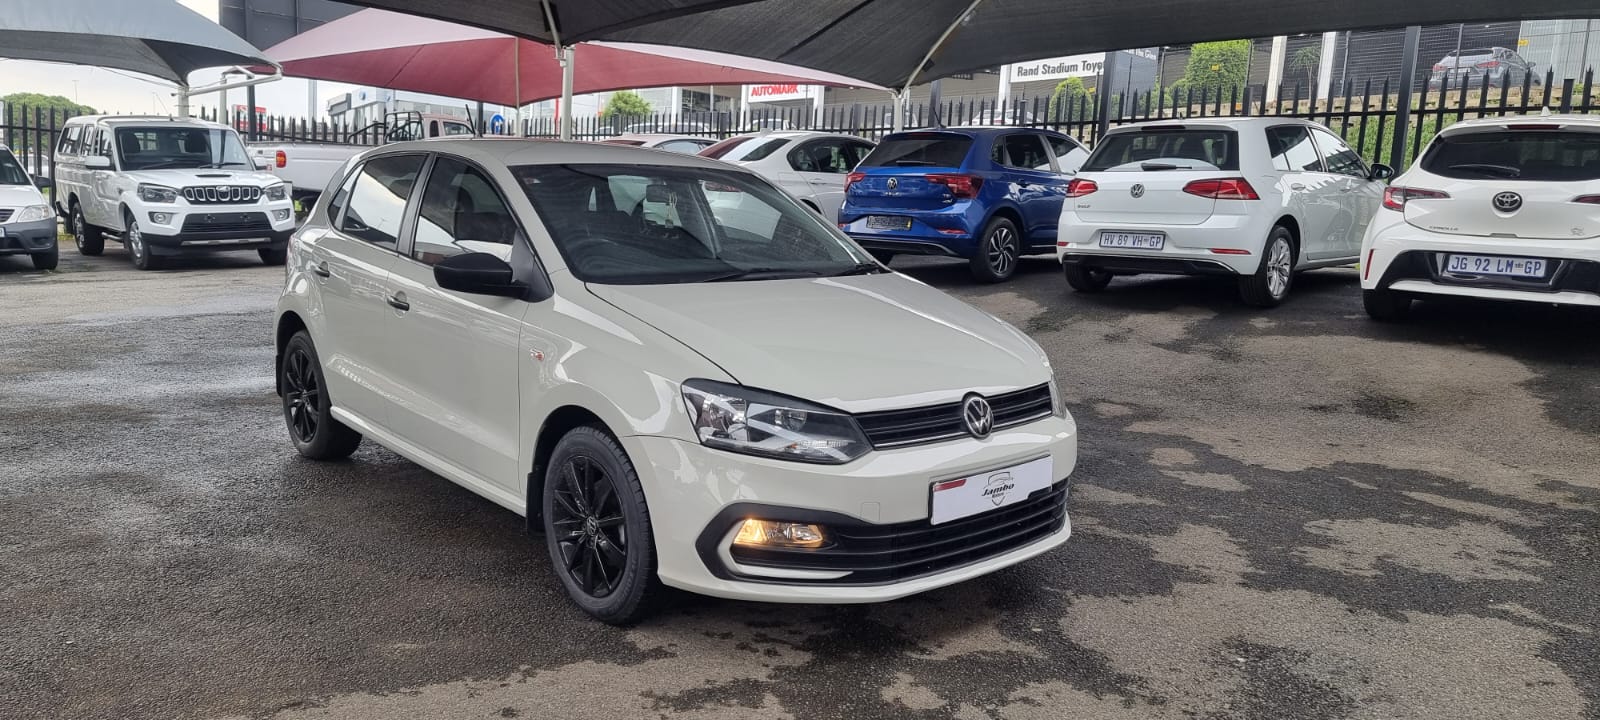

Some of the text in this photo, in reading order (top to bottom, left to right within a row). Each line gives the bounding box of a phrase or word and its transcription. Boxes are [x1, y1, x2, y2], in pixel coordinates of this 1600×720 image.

[1017, 66, 1039, 77] Rand
[1041, 62, 1078, 75] Stadium
[751, 84, 799, 96] AUTOMARK
[1103, 234, 1161, 248] HV 89 VH GP
[1452, 256, 1542, 275] JG 92 LM GP
[981, 484, 1014, 496] Jambo
